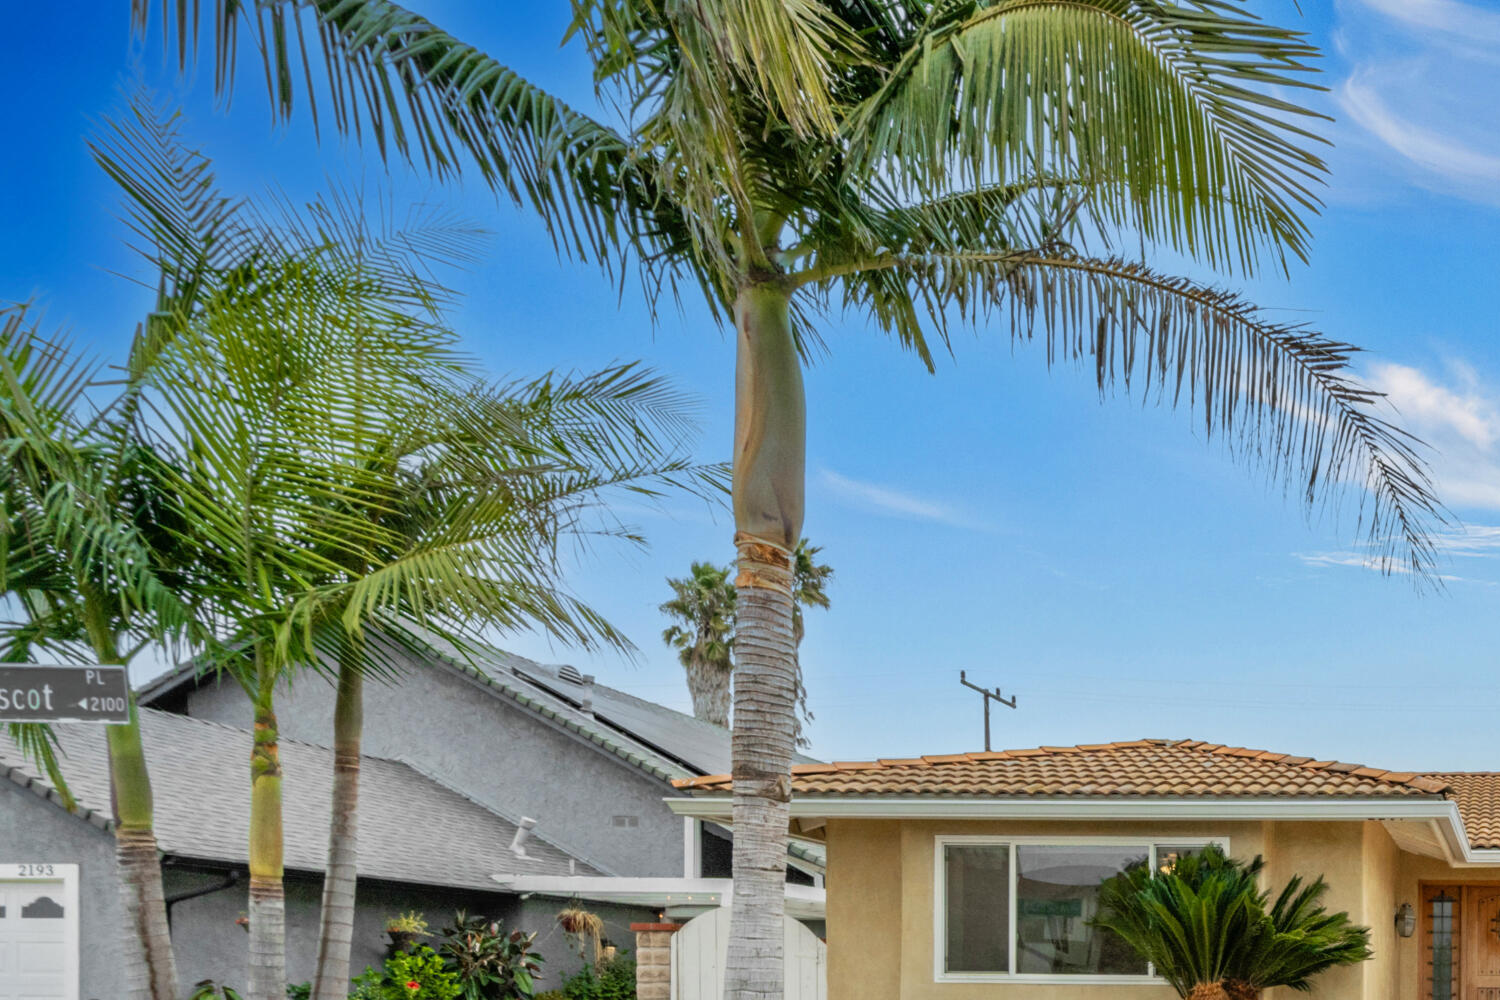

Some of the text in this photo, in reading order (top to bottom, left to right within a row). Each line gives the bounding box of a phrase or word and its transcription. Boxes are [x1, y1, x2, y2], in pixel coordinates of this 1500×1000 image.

[85, 669, 106, 685] PL
[90, 696, 125, 712] 2100
[17, 863, 55, 877] 2193
